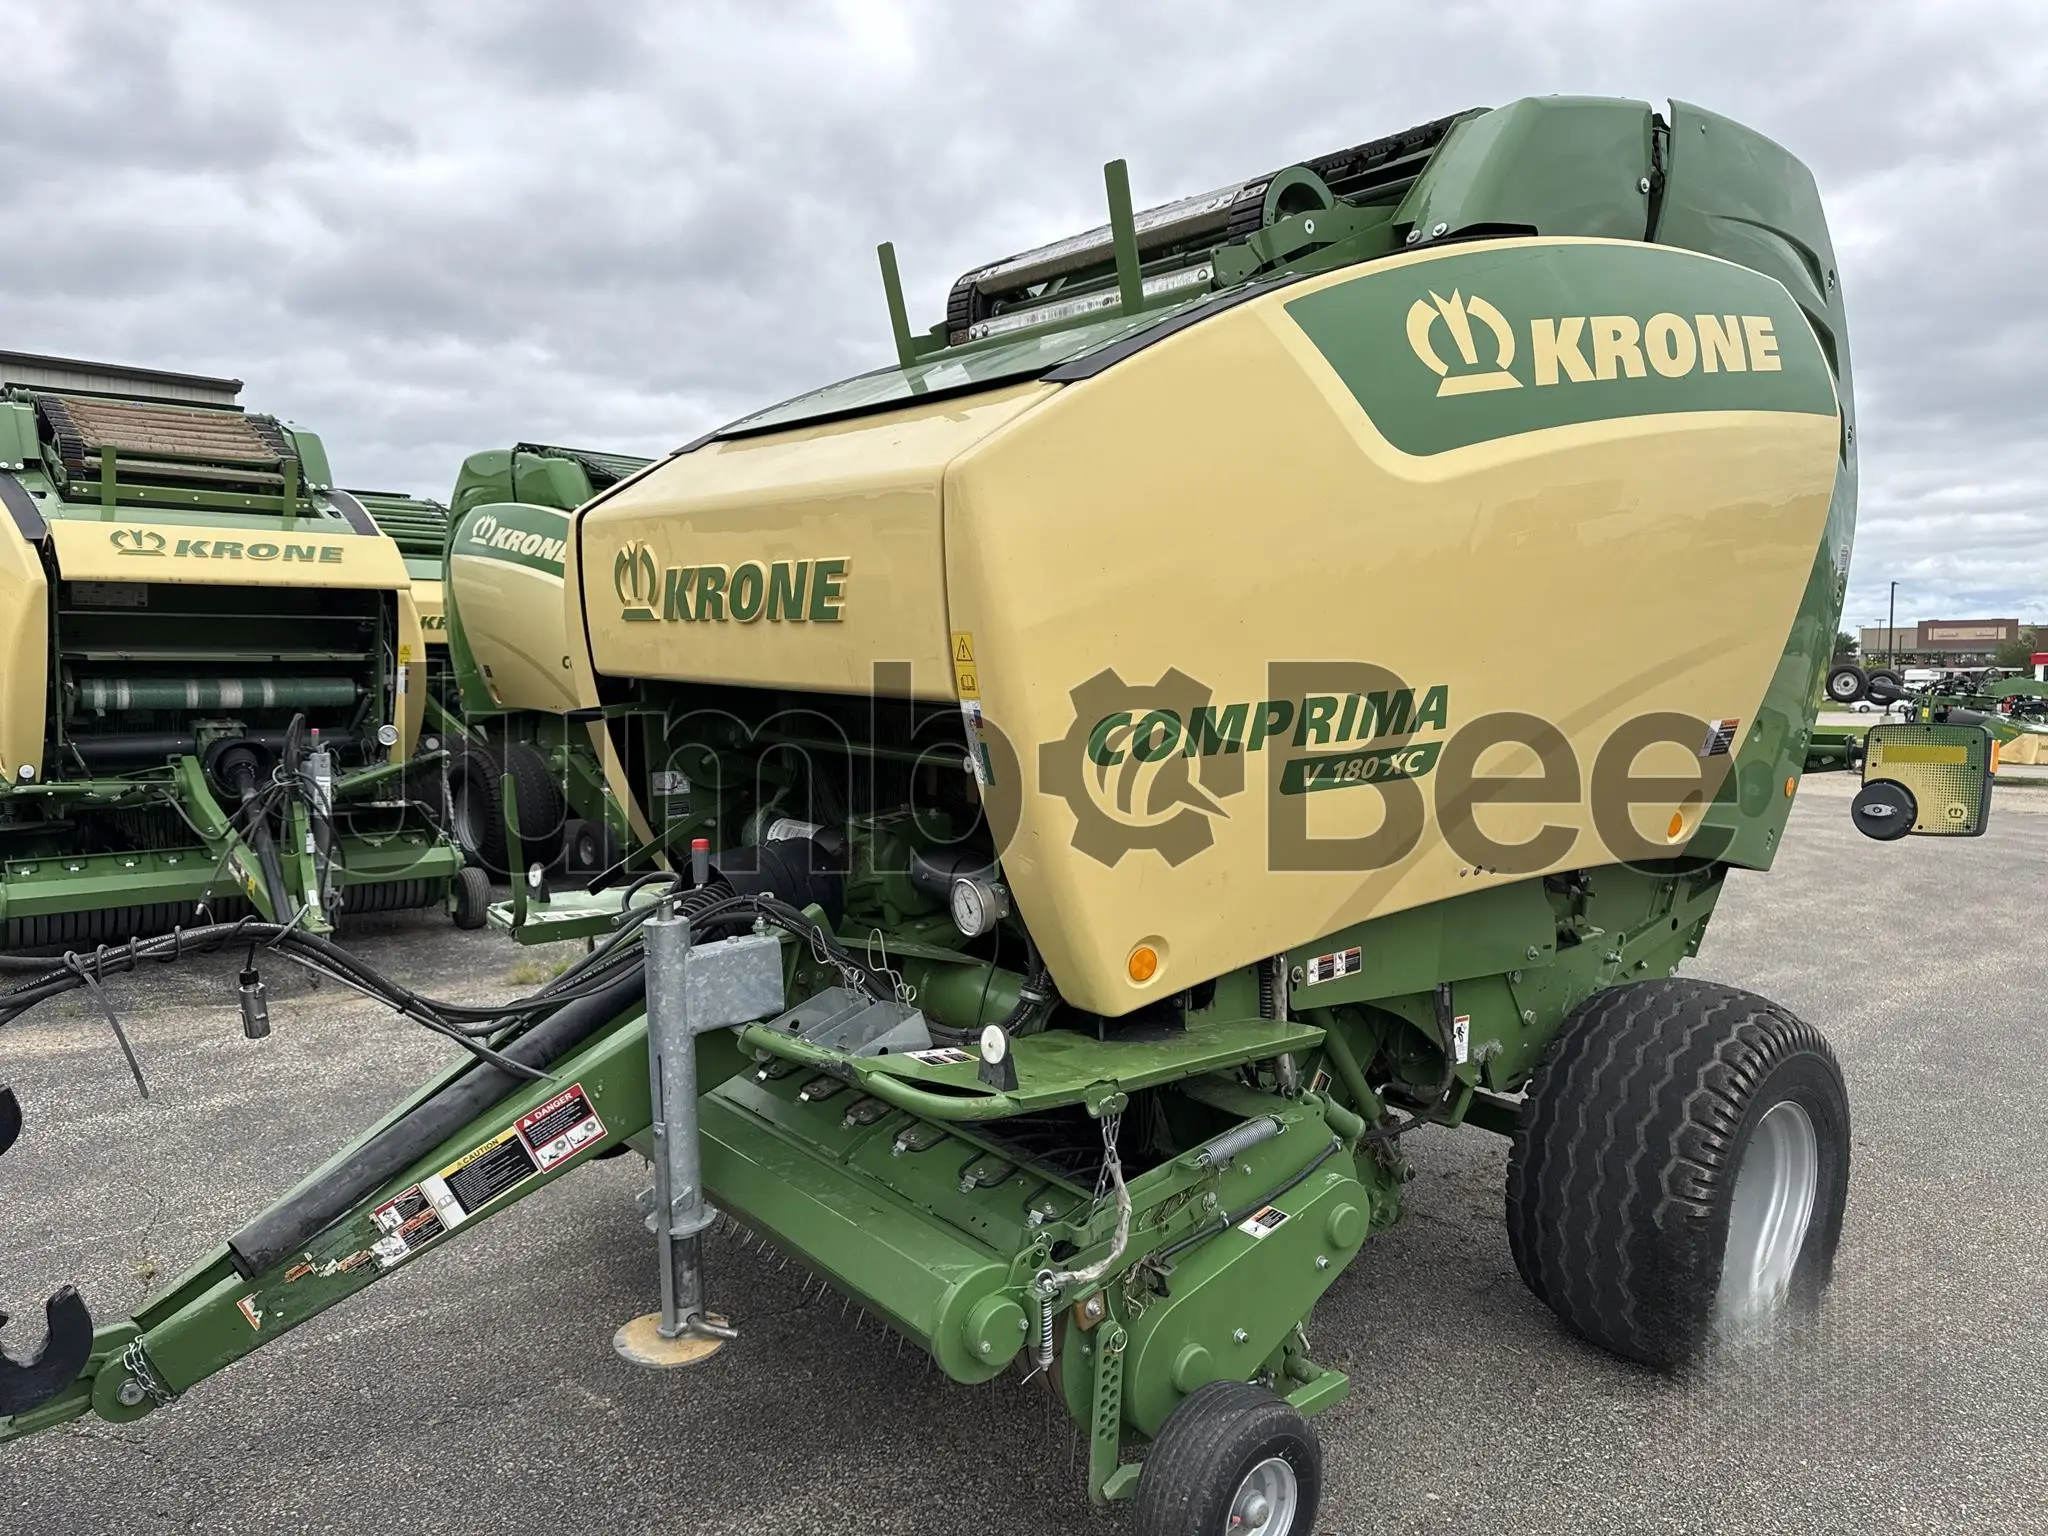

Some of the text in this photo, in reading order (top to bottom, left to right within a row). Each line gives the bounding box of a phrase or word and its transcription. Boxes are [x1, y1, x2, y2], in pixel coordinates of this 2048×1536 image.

[1531, 312, 1782, 386] KRONE
[174, 540, 344, 563] KRONE
[663, 556, 850, 622] KRONE
[1088, 685, 1448, 766] COMPRIMA
[1304, 750, 1425, 787] V 180 XC
[534, 1092, 573, 1120] DANGER
[463, 1138, 499, 1164] CAUTION
